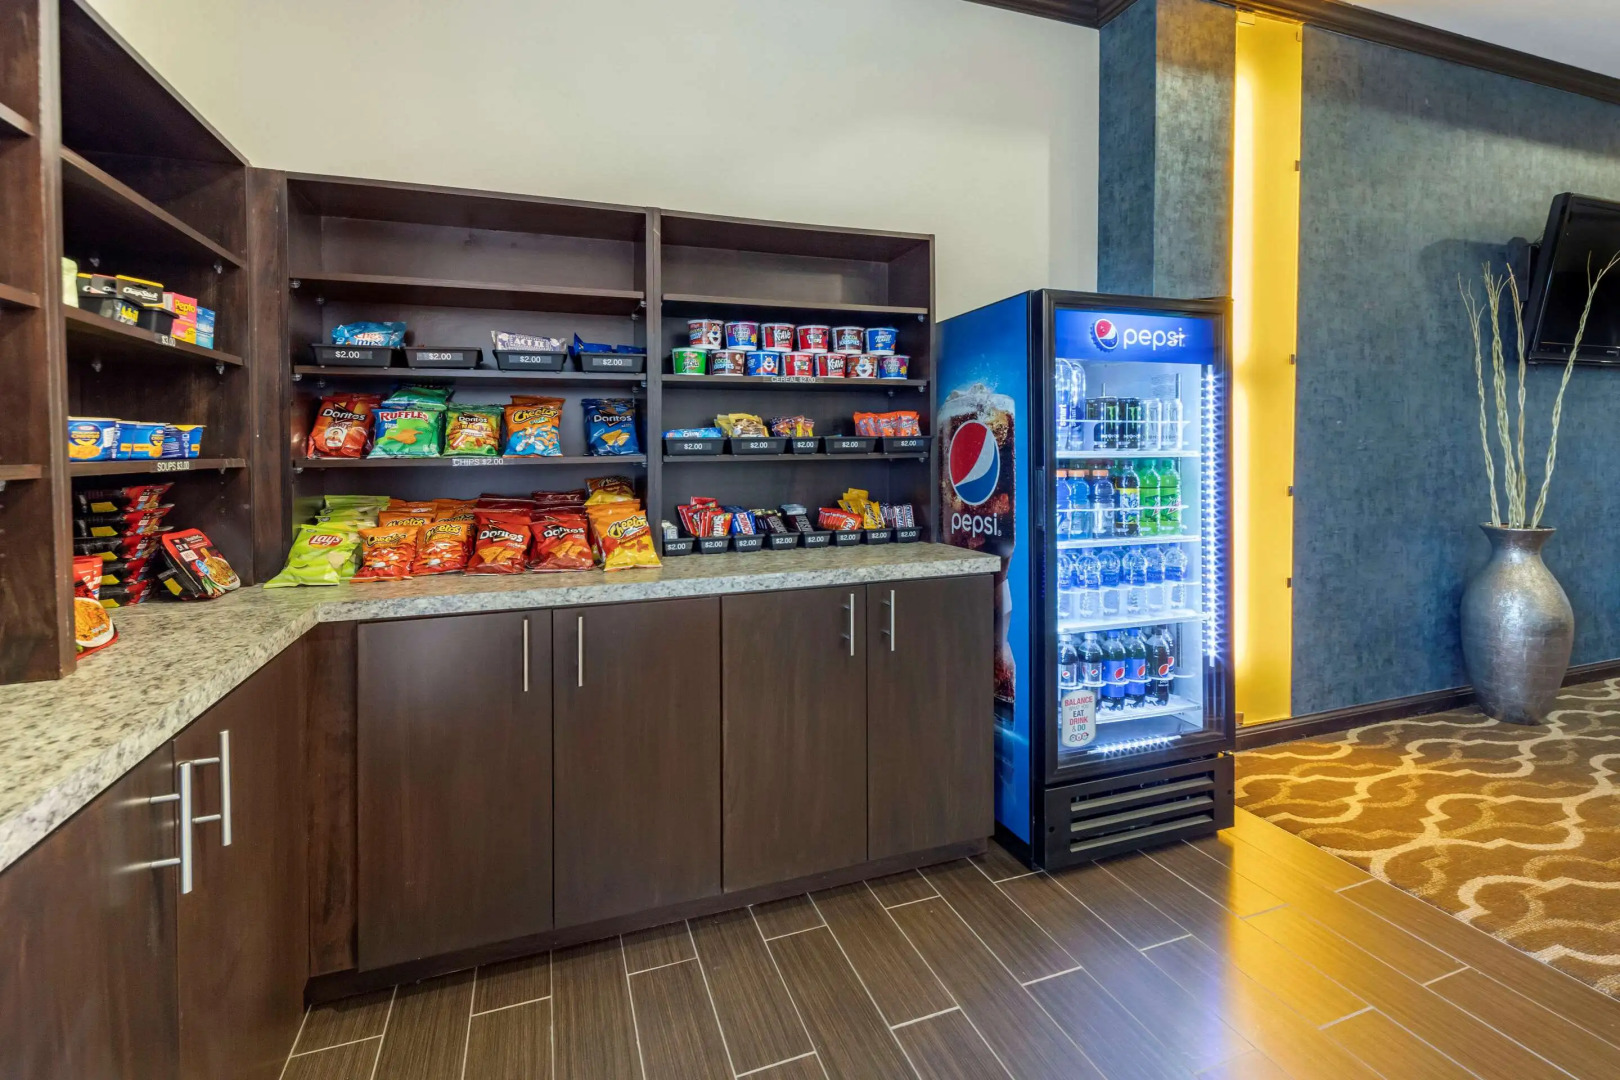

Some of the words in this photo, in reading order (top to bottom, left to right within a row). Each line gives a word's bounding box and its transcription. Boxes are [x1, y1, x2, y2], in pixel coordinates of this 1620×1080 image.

[174, 299, 196, 313] Pepto
[514, 338, 532, 347] ACT
[1123, 327, 1186, 351] pepsi
[335, 350, 360, 359] $2.00
[428, 352, 452, 360] $2.00
[519, 355, 541, 363] $2.00
[602, 358, 623, 366] $2.00
[322, 408, 366, 421] Doritos
[379, 411, 429, 423] RUFFLES
[512, 408, 559, 423] Cheetos
[593, 414, 633, 423] Doritos
[750, 441, 768, 449] $2.00
[157, 461, 176, 472] SOUPS
[453, 458, 480, 466] CHIPS
[481, 458, 504, 466] $2.00
[608, 515, 648, 538] Cheetos
[951, 512, 998, 537] pepsi
[479, 530, 525, 543] Doritos
[543, 526, 585, 539] Doritos
[739, 539, 757, 547] $2.00
[1064, 695, 1093, 707] BALANCE
[1072, 710, 1084, 718] EAT
[1069, 716, 1088, 725] DRINK
